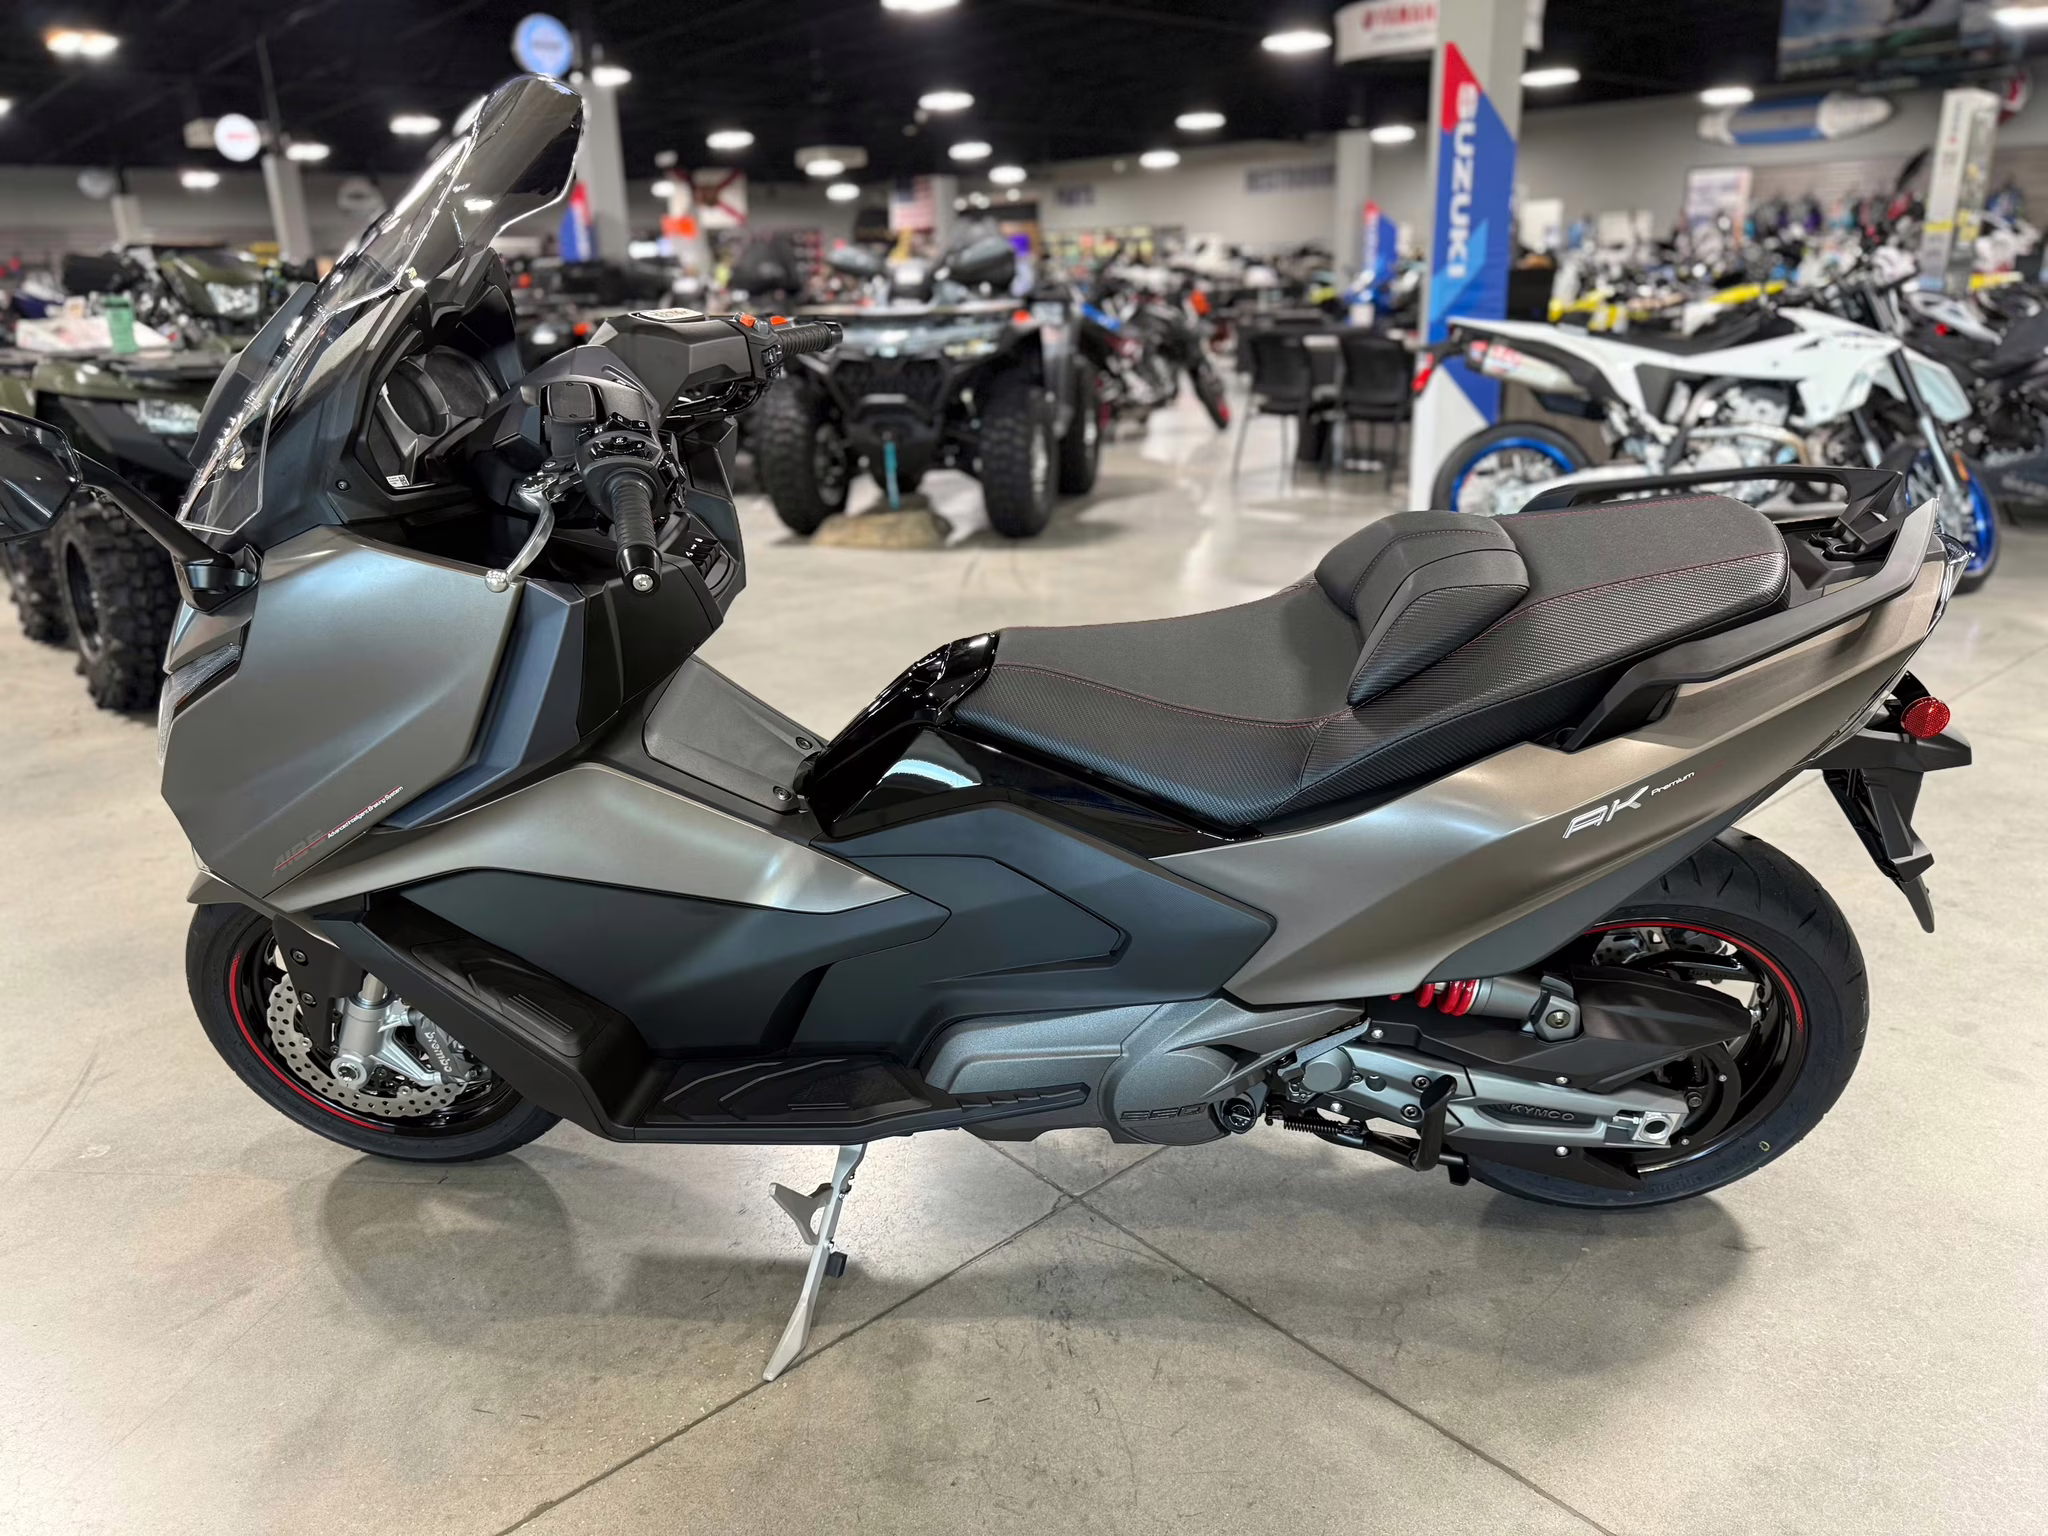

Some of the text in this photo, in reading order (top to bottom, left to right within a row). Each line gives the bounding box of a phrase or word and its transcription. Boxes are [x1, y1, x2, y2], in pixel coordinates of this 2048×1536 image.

[1446, 82, 1479, 279] SUZUKI
[1651, 771, 1695, 796] Premium
[327, 820, 350, 839] Advanced
[367, 797, 387, 812] Braking
[384, 786, 404, 801] System
[1562, 785, 1650, 839] AK
[424, 1031, 453, 1073] brembo
[1509, 1103, 1576, 1122] KYMCO
